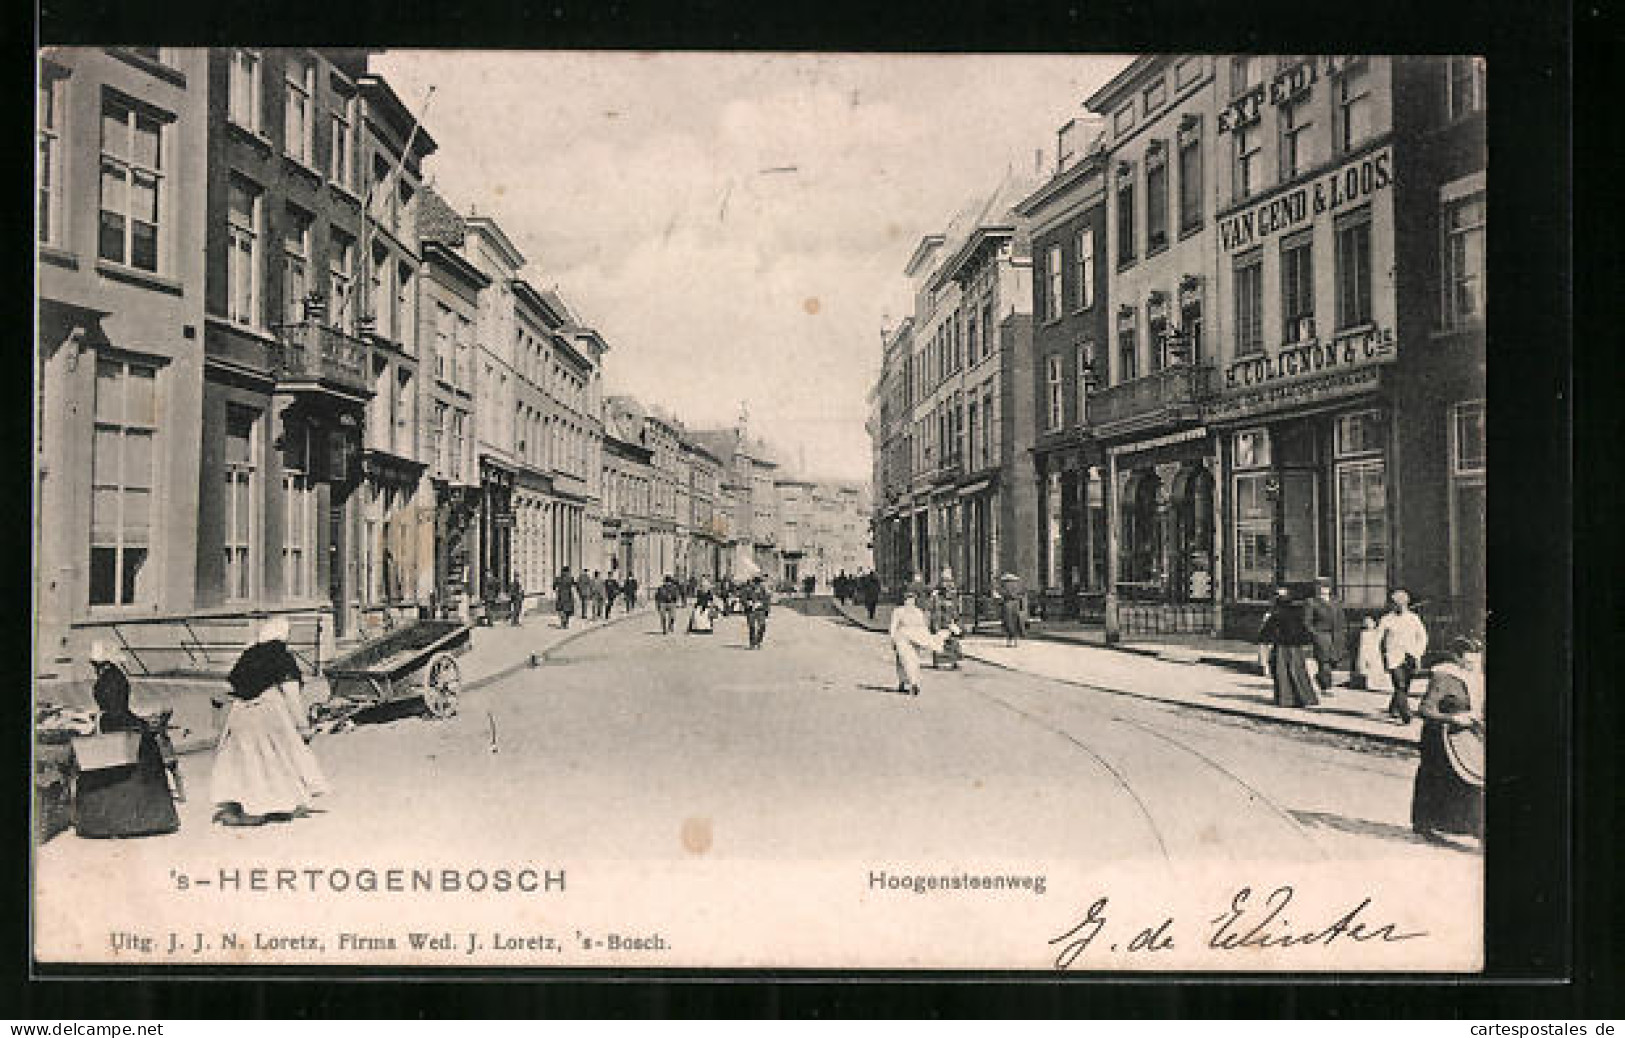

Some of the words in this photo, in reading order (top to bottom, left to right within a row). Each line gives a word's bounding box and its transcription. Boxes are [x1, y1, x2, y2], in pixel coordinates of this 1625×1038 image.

[1220, 210, 1254, 252] VAN
[1257, 187, 1306, 237] GEND
[1313, 182, 1328, 215] &
[868, 872, 1047, 895] Hoogensteenweg
[109, 932, 157, 954] Uitg.
[167, 933, 185, 955] J.
[193, 933, 211, 955] J.
[222, 933, 246, 950] N.
[256, 932, 327, 952] Loretz,
[338, 933, 397, 950] Firma
[408, 933, 458, 951] Wed.
[466, 933, 484, 955] J.
[494, 933, 563, 953] Loretz,
[1127, 917, 1175, 952] de
